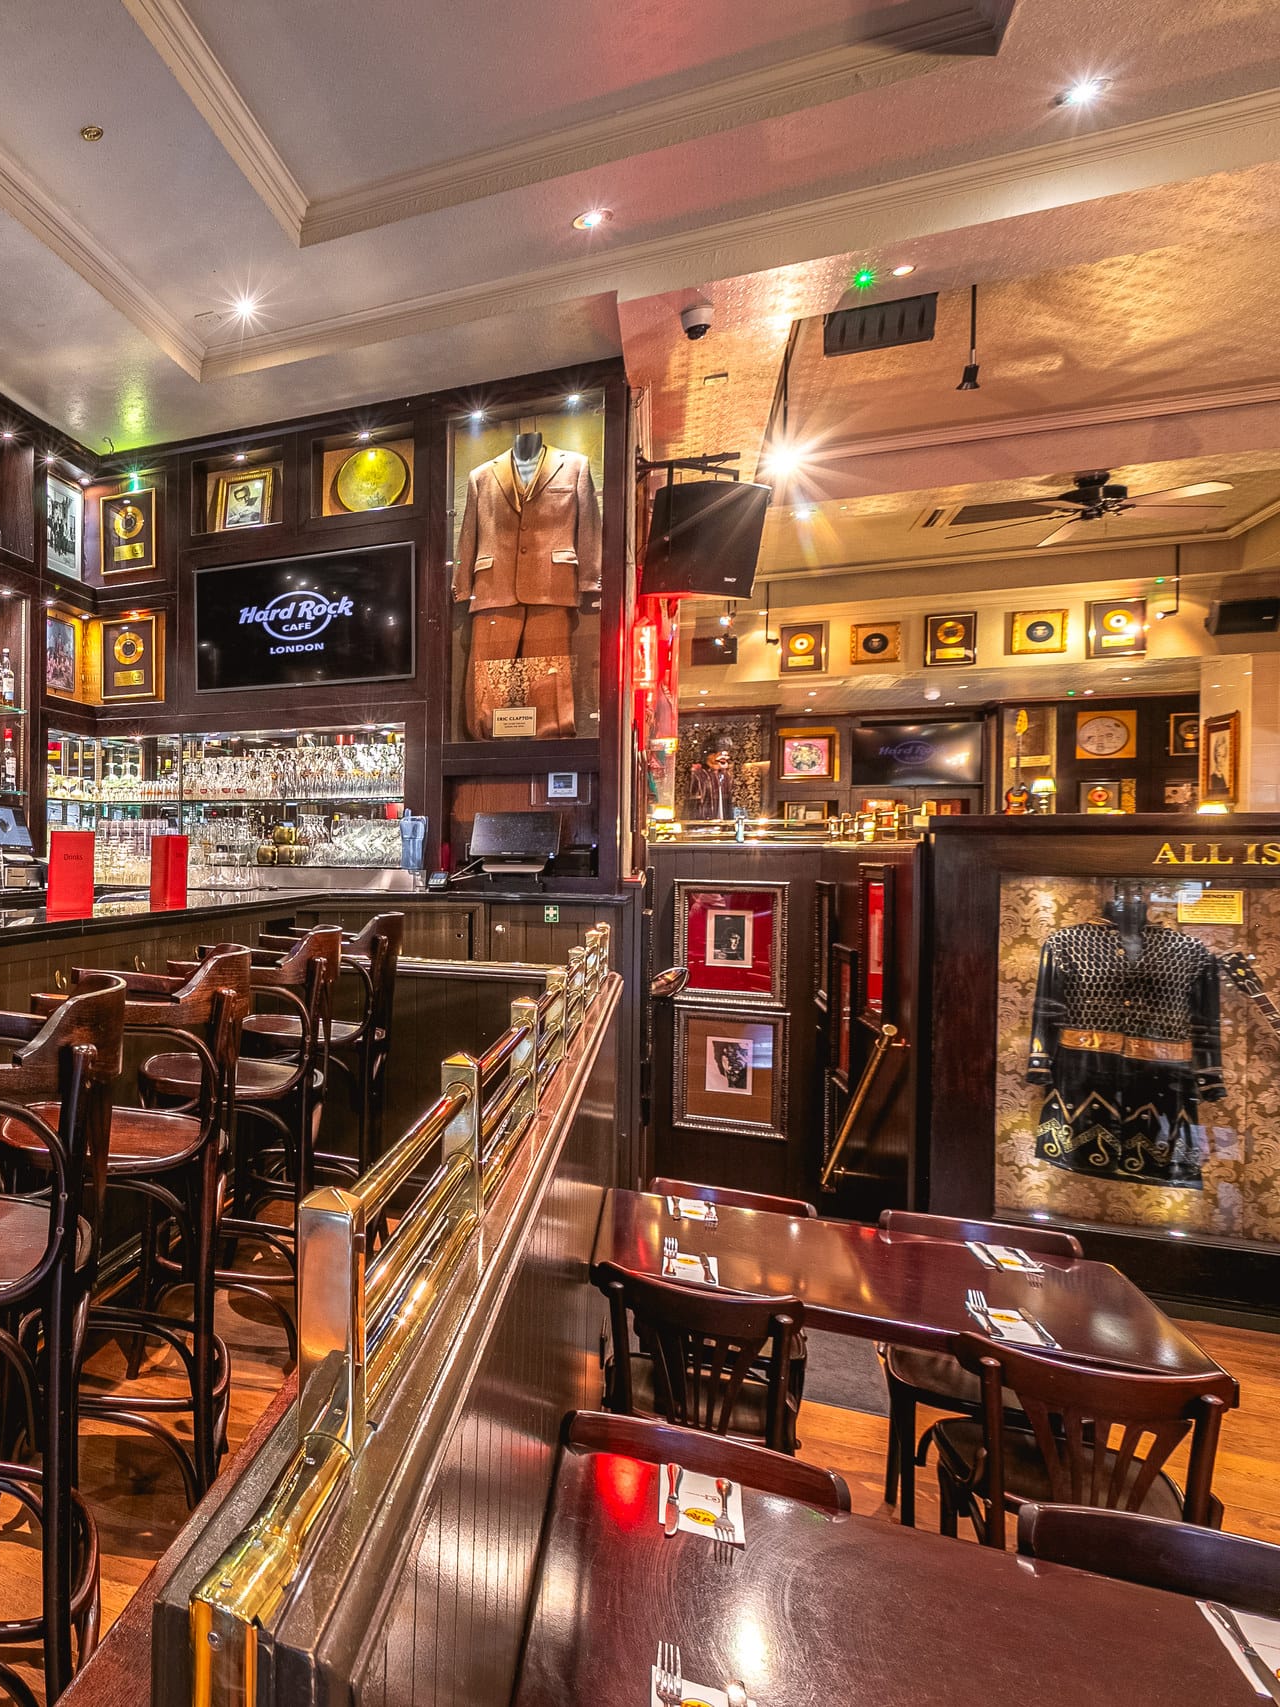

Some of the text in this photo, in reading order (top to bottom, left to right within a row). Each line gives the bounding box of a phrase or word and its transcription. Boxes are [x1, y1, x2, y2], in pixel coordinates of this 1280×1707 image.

[238, 596, 354, 624] Hard Rock
[282, 622, 312, 632] CAFE
[269, 642, 325, 655] LONDON
[64, 853, 84, 861] Drinks
[1152, 842, 1280, 865] ALL IS
